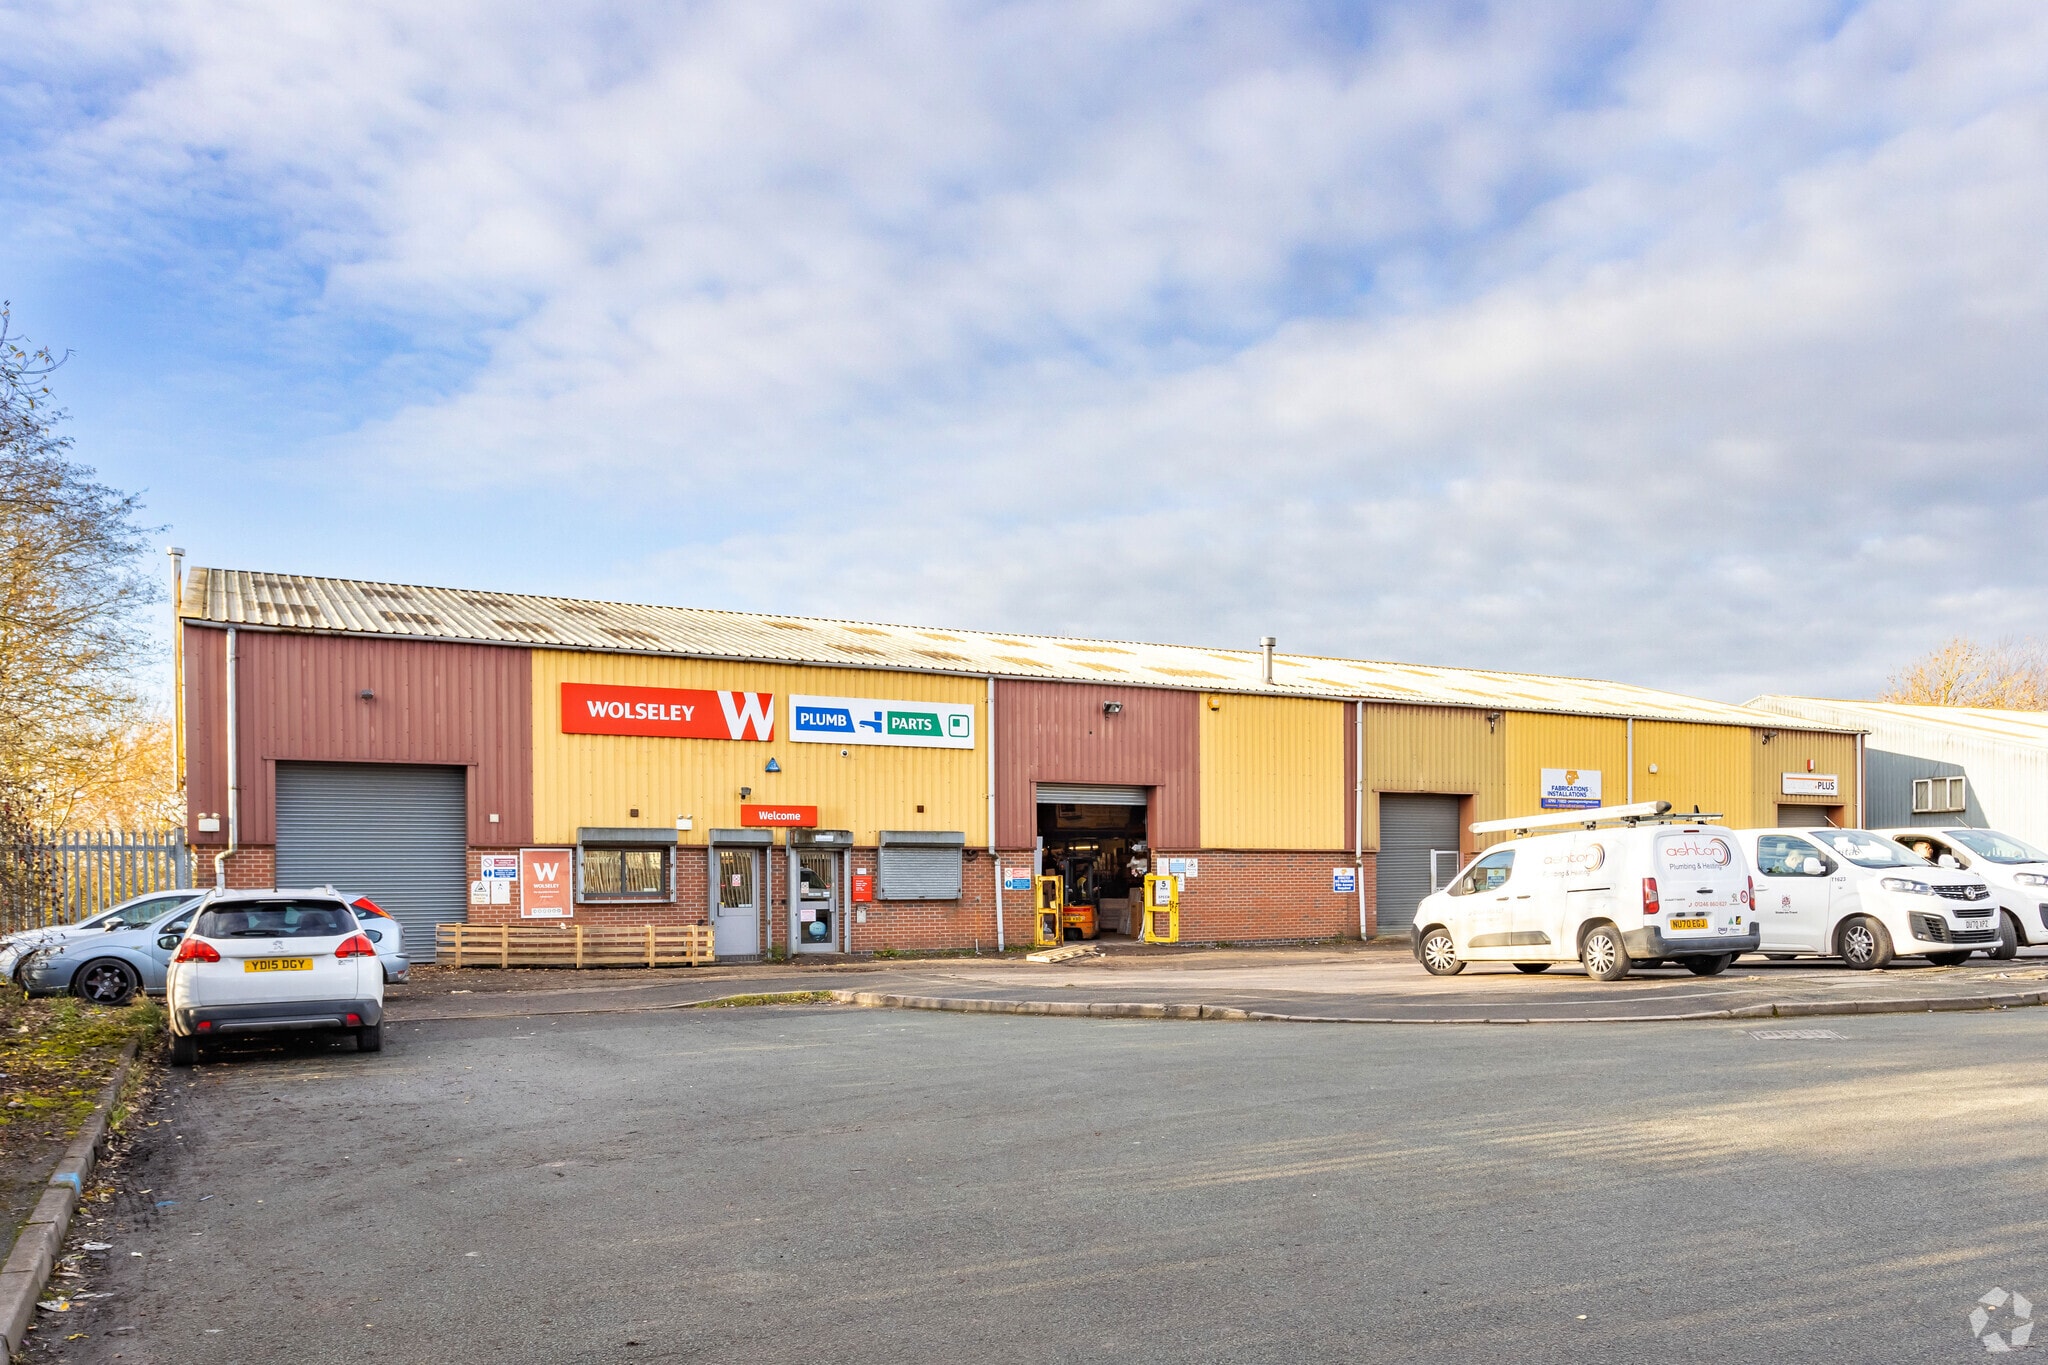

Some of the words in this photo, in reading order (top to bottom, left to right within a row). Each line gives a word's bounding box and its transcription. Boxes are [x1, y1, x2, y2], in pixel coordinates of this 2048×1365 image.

[587, 700, 695, 722] WOLSELEY
[717, 690, 774, 741] W
[800, 712, 847, 727] PLUMB
[891, 717, 932, 731] PARTS
[1817, 781, 1835, 790] PLUS
[1547, 790, 1587, 798] INSTALLATIONS
[758, 811, 801, 820] Welcome
[1666, 841, 1722, 856] ashton
[533, 862, 559, 881] W
[1672, 920, 1692, 928] NU70
[1692, 919, 1705, 928] EGJ
[251, 960, 279, 970] YD15
[282, 959, 305, 969] DGY
